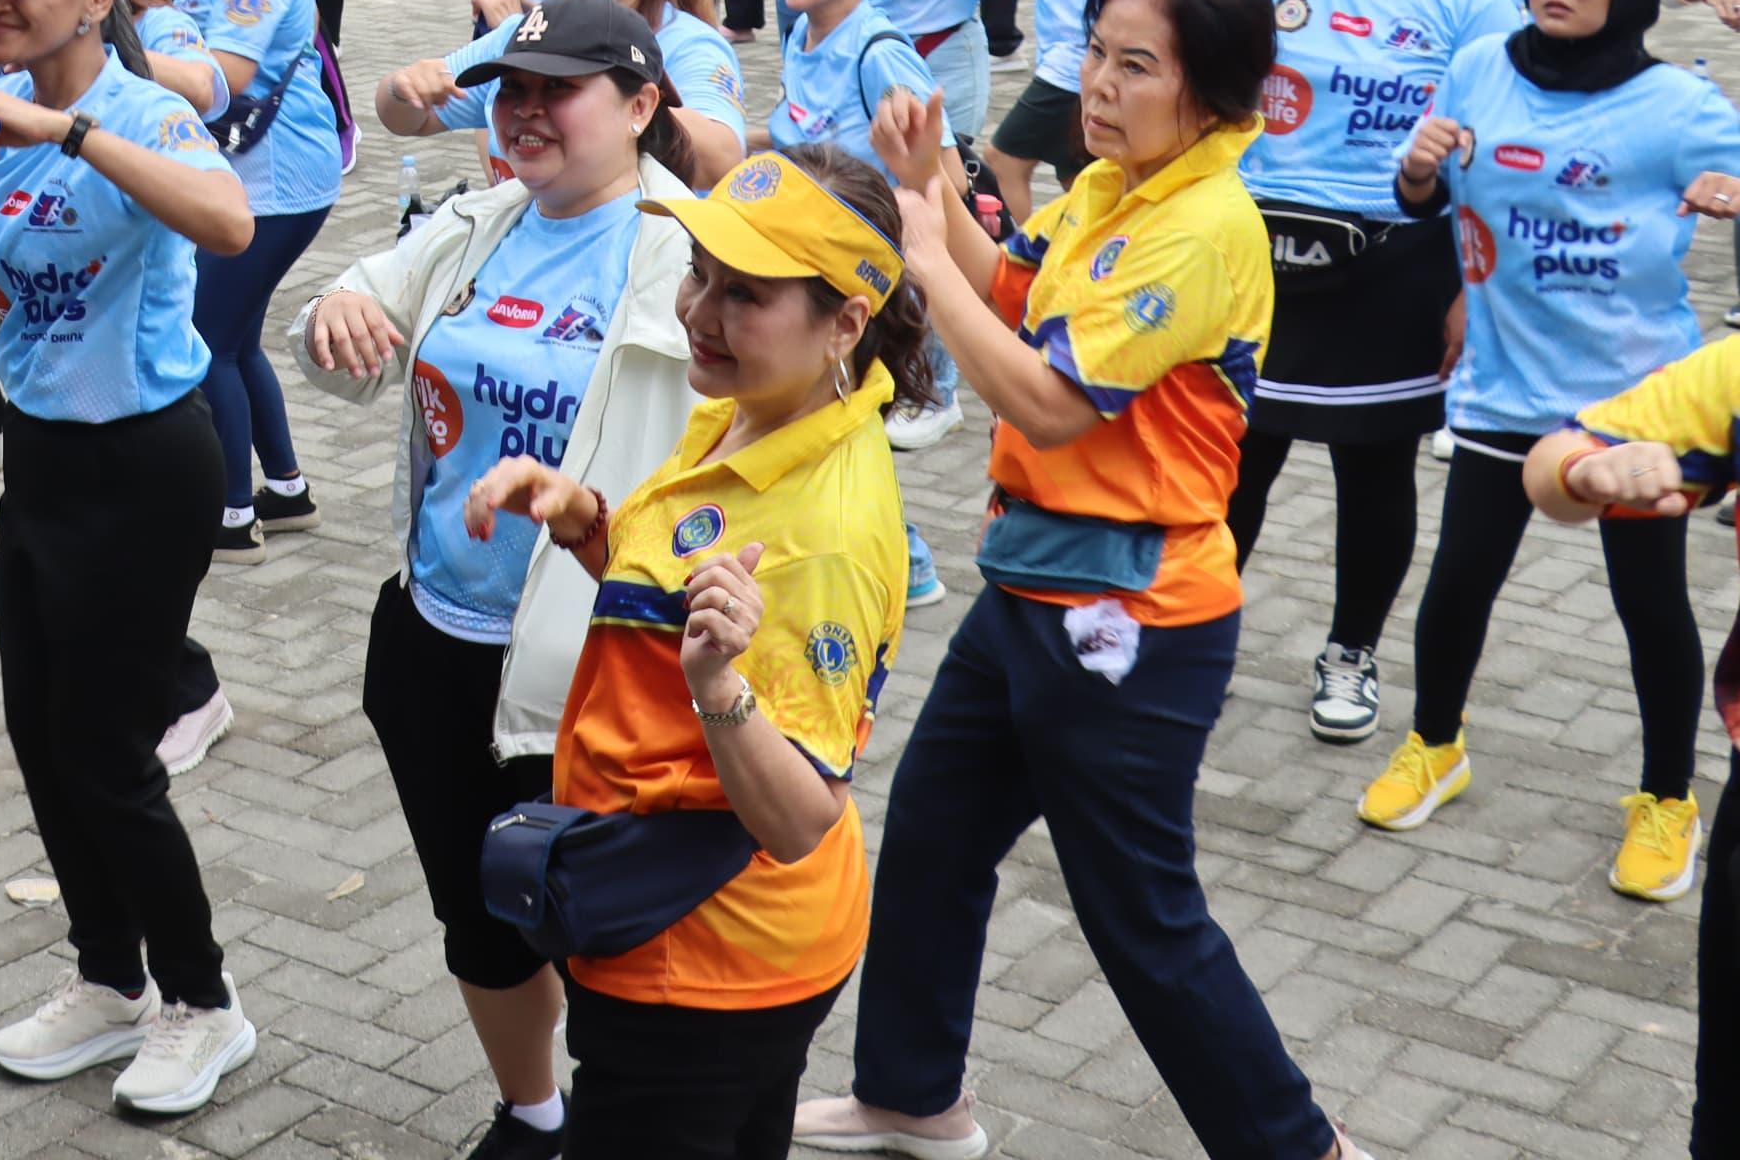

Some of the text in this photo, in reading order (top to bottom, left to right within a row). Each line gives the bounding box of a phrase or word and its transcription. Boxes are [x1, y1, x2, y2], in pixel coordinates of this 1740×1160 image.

[517, 5, 548, 42] LA
[1330, 65, 1428, 107] hydro
[1508, 206, 1622, 250] hydro
[1274, 234, 1332, 266] ILA
[1533, 249, 1620, 281] plus
[0, 258, 97, 301] hydro
[416, 374, 447, 414] ilk
[473, 363, 580, 425] hydr
[499, 423, 568, 469] plu
